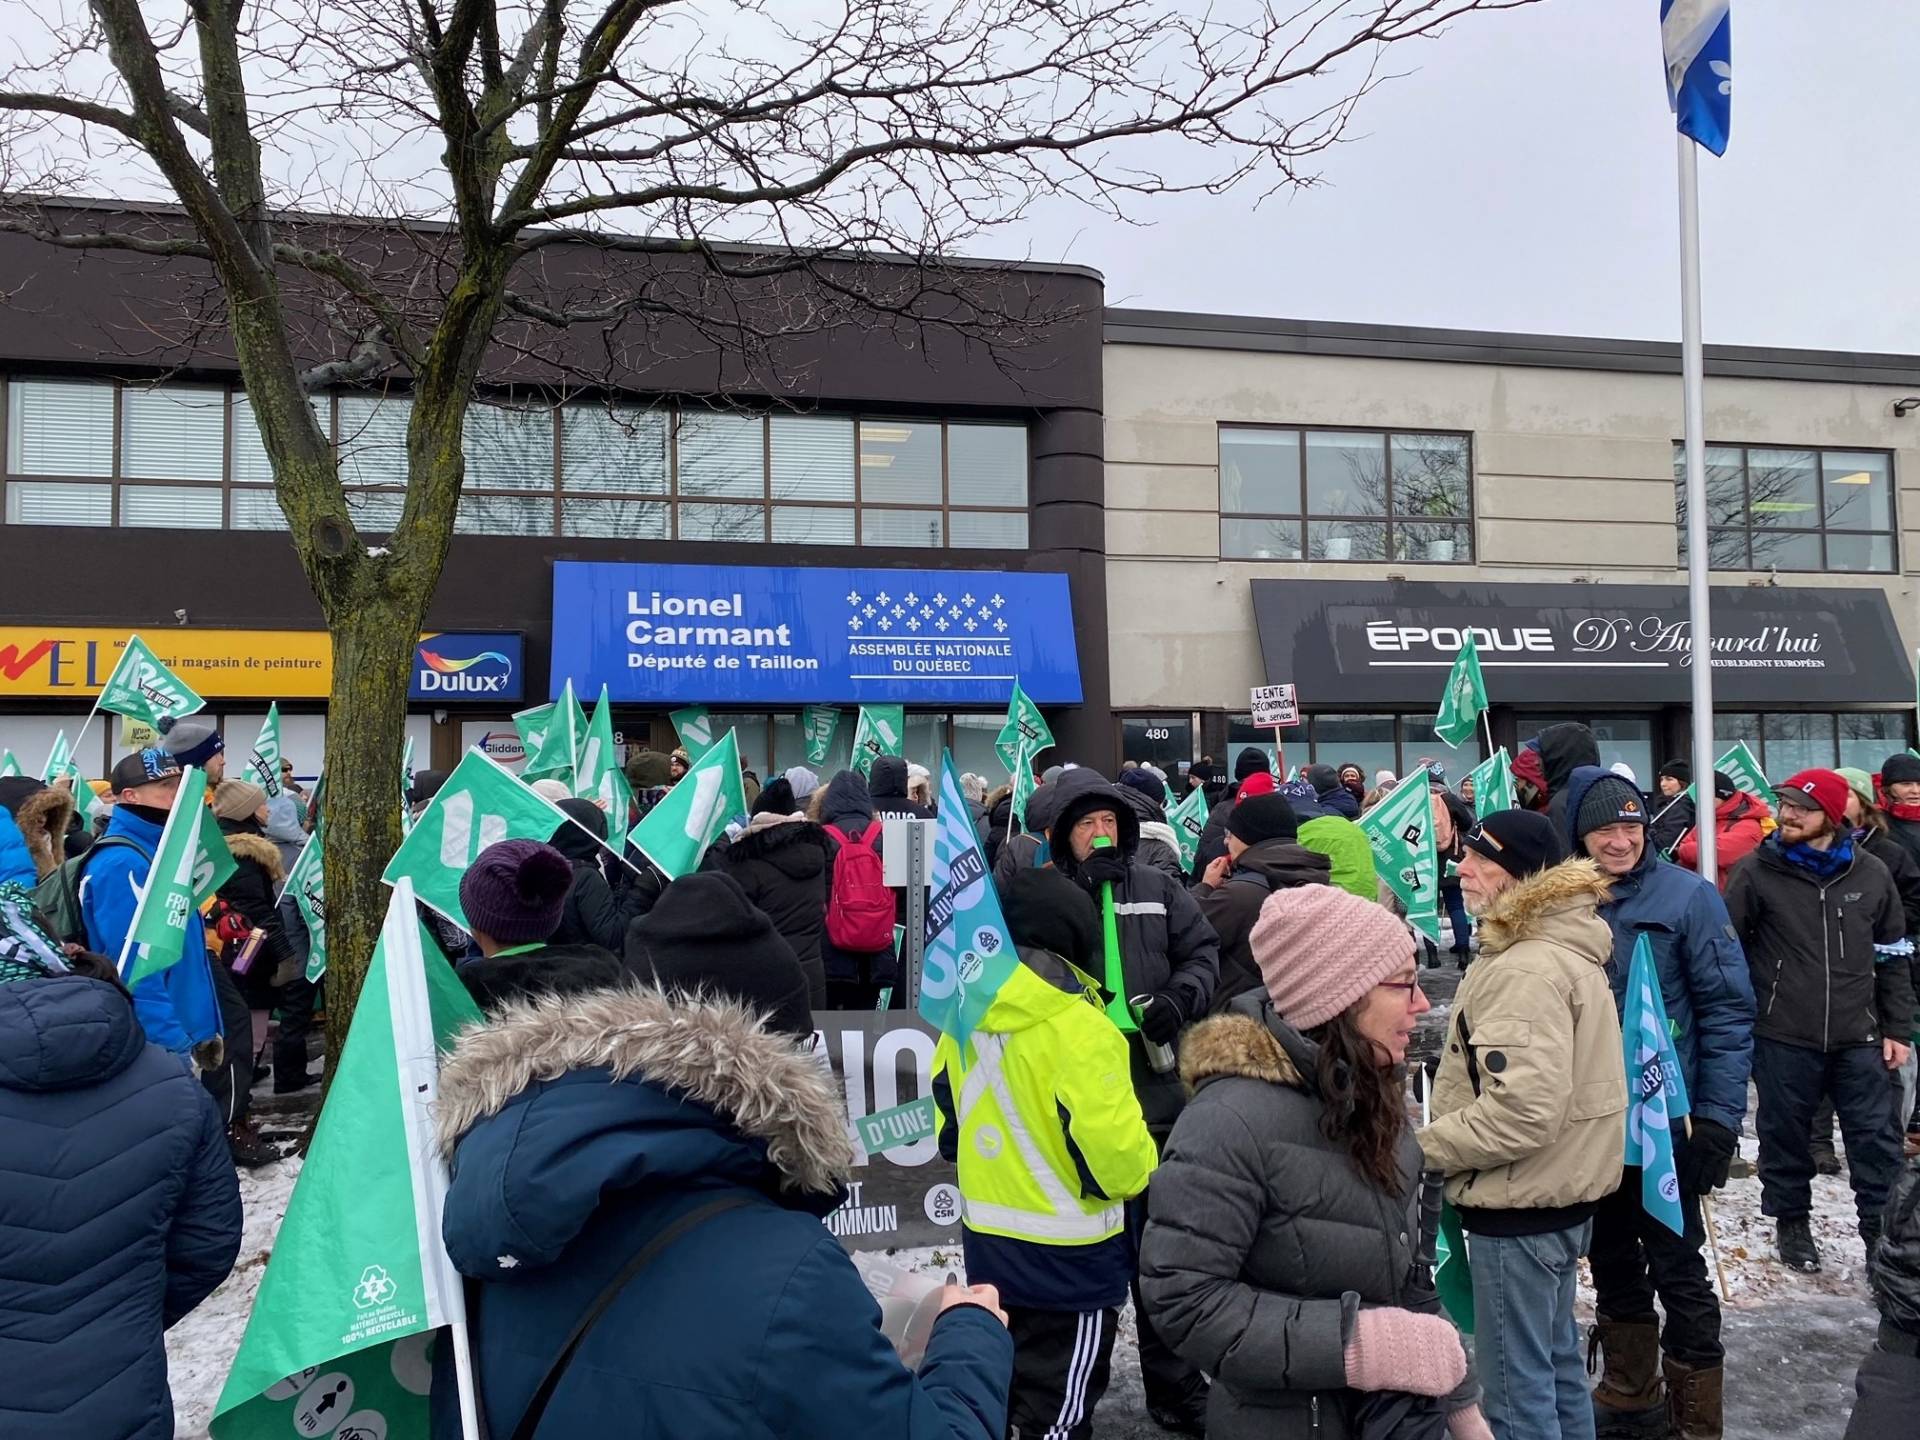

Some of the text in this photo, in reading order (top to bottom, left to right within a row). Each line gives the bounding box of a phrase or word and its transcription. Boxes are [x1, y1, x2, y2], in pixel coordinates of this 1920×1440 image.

[628, 591, 742, 617] Lionel
[626, 620, 791, 647] Carmant
[1366, 620, 1555, 651] ÉPOQUE
[849, 643, 1012, 656] ASSEMBLÉE NATIONALE
[182, 656, 240, 670] magasin
[244, 657, 260, 668] de
[264, 657, 322, 671] peinture
[628, 653, 818, 671] Député de Taillon
[893, 658, 971, 672] DU QUÉBEC
[1711, 658, 1825, 668] MEUBLEMENT EUROPÉEN
[421, 669, 499, 692] Dulux
[1256, 687, 1285, 699] LENTE
[1145, 728, 1169, 740] 480
[484, 743, 525, 753] Glidden
[1212, 775, 1227, 784] 480
[866, 1106, 932, 1147] D'UNE
[934, 1209, 954, 1218] CSN
[342, 1314, 418, 1345] 100% RECYCLABLE
